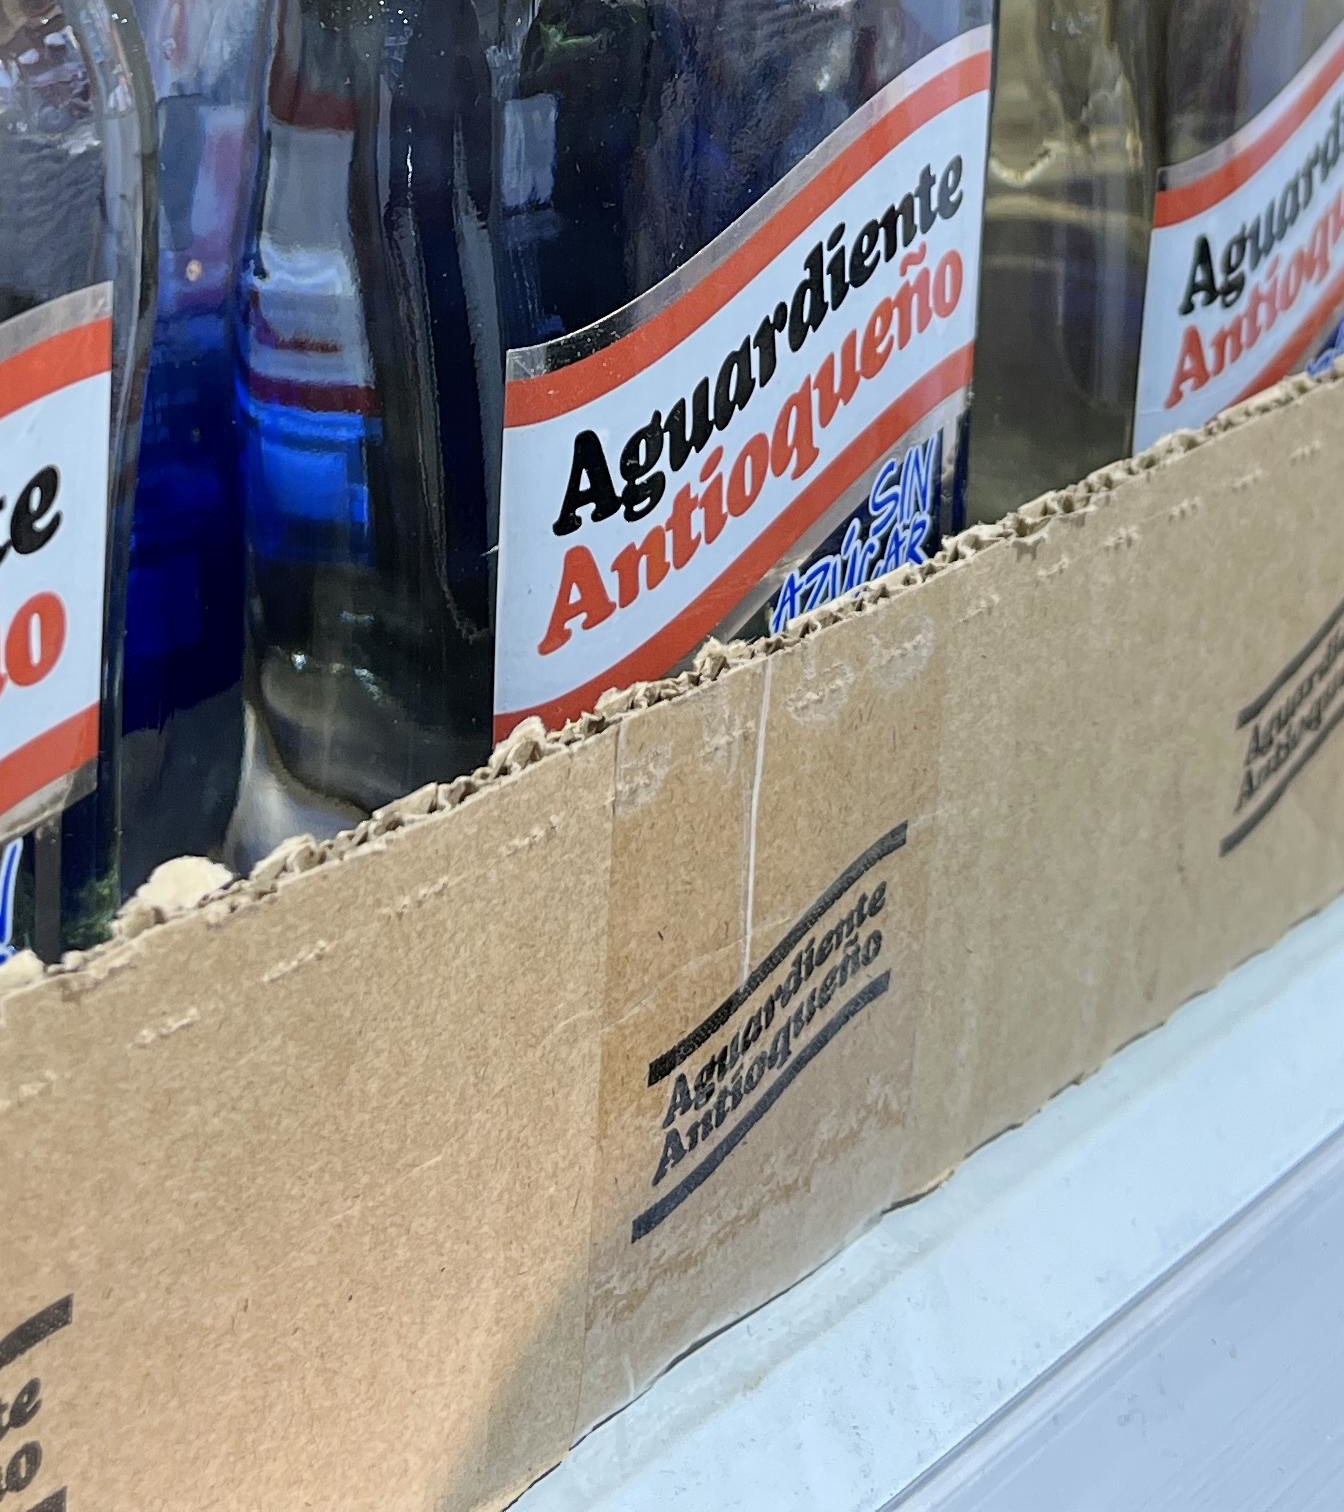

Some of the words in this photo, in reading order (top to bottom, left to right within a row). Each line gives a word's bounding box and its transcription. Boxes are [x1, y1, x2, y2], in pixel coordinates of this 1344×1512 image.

[536, 240, 965, 658] Antioqueño
[551, 153, 965, 539] Aguardiente
[868, 436, 939, 538] SIN
[649, 927, 885, 1188] Antioqueño
[662, 880, 889, 1132] Aguardiente
